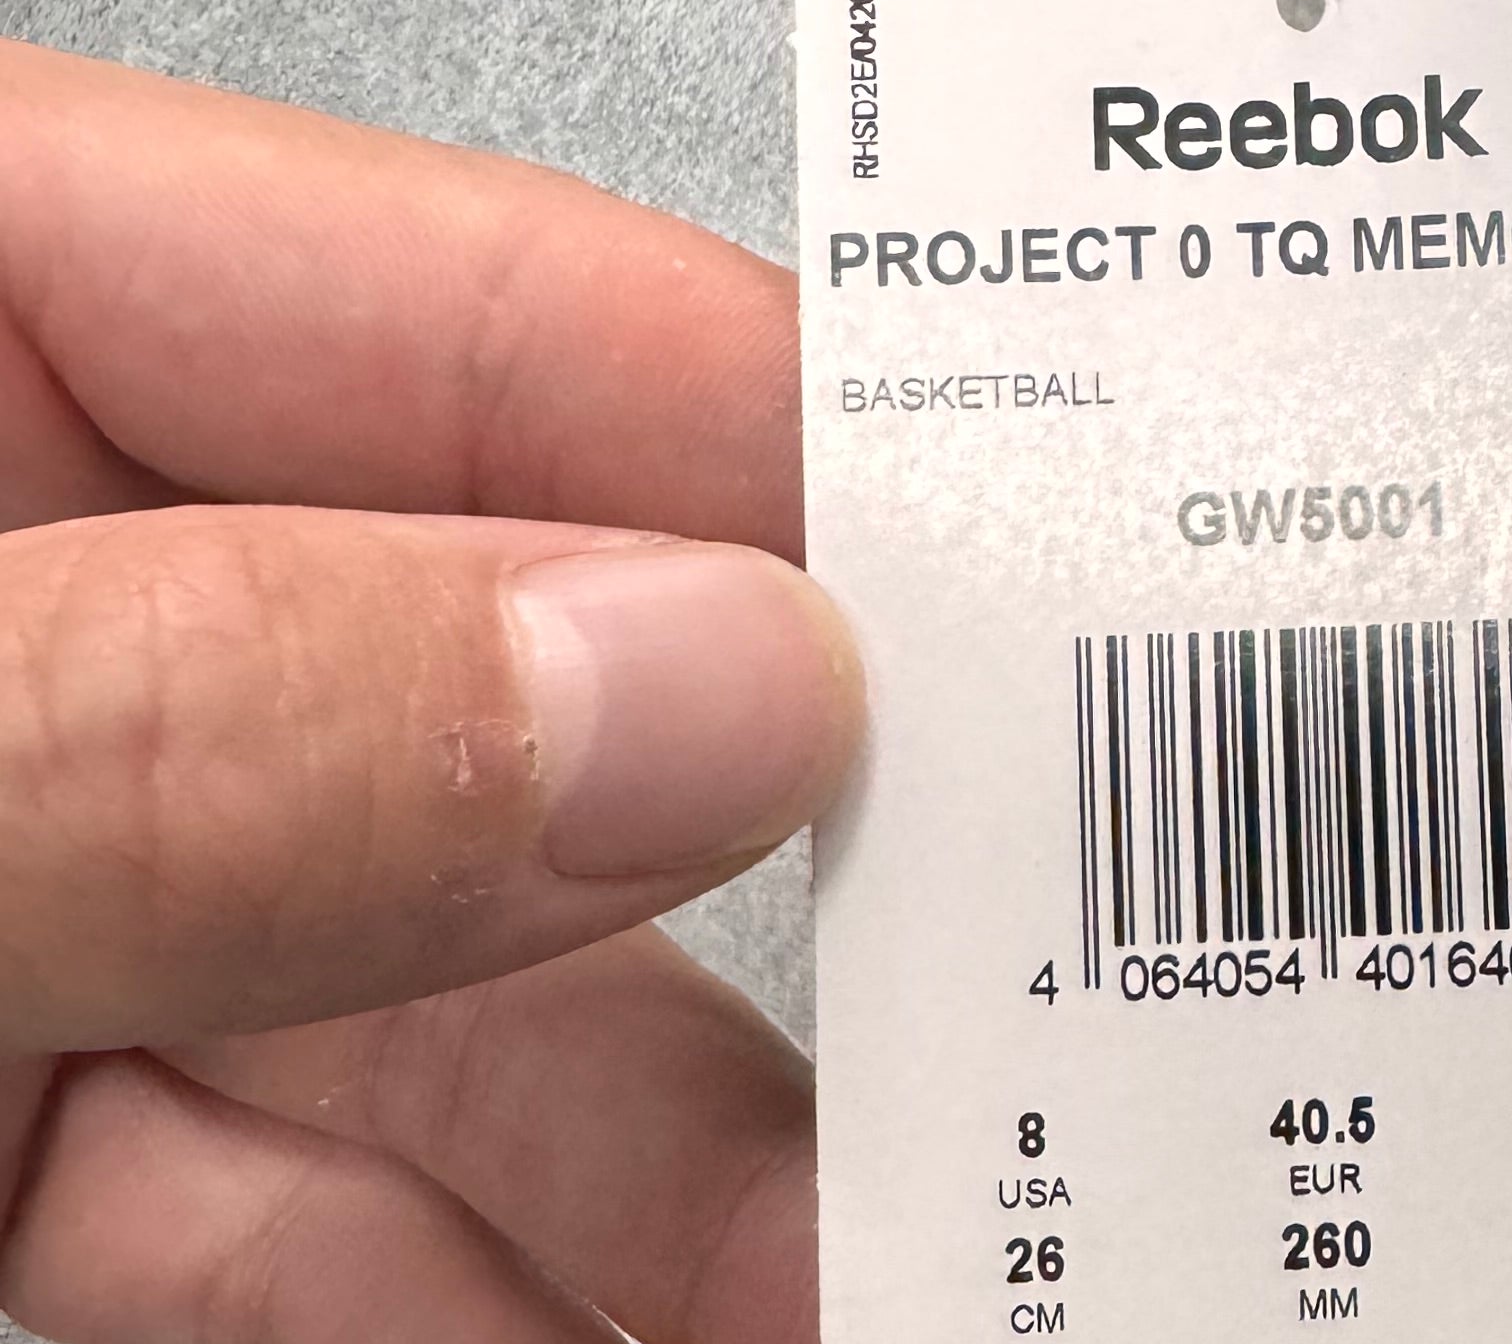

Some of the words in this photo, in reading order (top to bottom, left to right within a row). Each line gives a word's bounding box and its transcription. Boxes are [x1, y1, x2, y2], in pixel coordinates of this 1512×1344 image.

[1092, 73, 1490, 172] Reebok
[829, 225, 1157, 288] PROJECT
[1179, 223, 1212, 280] 0
[1235, 219, 1330, 279] TQ
[840, 370, 1116, 414] BASKETBALL
[1176, 479, 1444, 547] GW5001
[1027, 958, 1060, 1007] 4
[1119, 946, 1306, 1003] 064054
[1017, 1111, 1046, 1159] 8
[1269, 1095, 1376, 1151] 40.5
[998, 1176, 1073, 1210] USA
[1288, 1162, 1364, 1199] EUR
[1004, 1234, 1065, 1285] 26
[1280, 1219, 1372, 1272] 260
[1009, 1301, 1066, 1335] CM
[1297, 1286, 1359, 1323] MM
